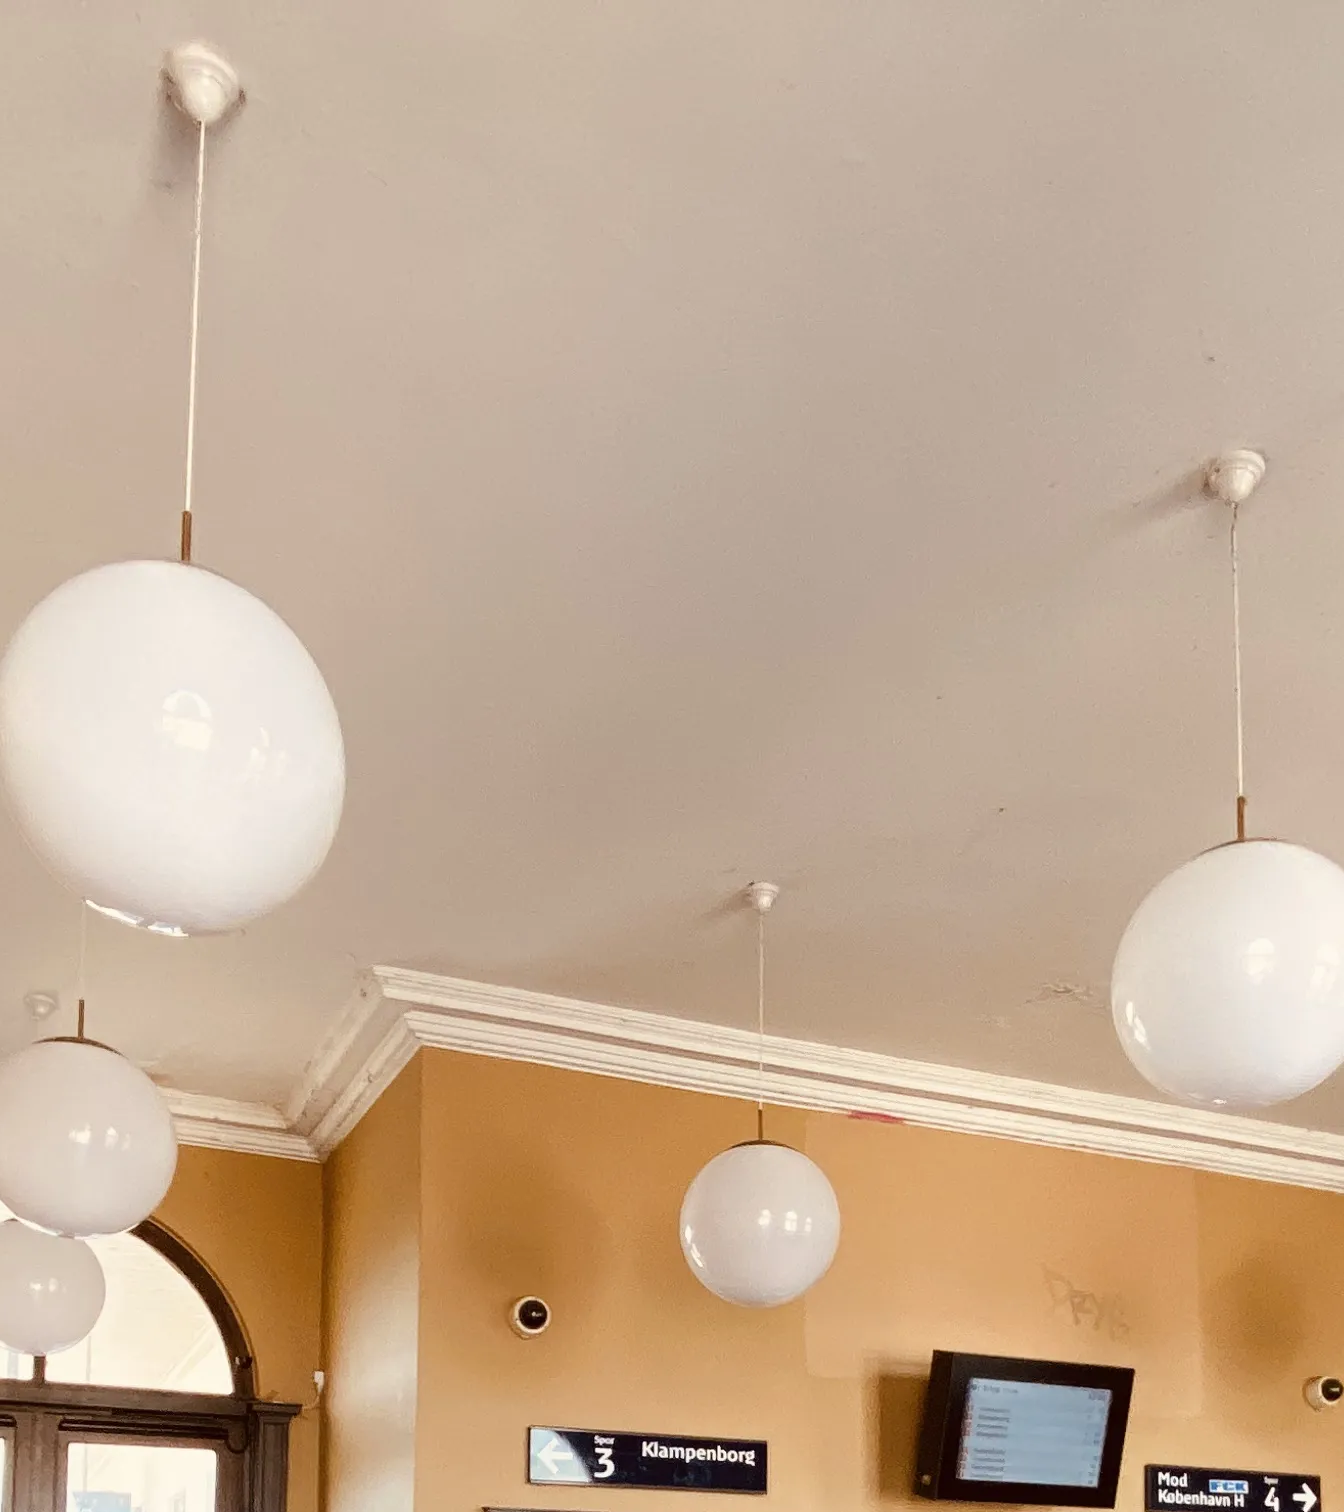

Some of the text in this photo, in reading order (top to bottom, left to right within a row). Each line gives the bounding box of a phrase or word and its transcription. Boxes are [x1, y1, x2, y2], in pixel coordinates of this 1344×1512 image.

[594, 1435, 615, 1446] Spor
[593, 1447, 615, 1478] 3
[641, 1441, 756, 1466] Klampenborg
[1158, 1472, 1188, 1487] Mod
[1158, 1488, 1245, 1507] København H
[1264, 1486, 1280, 1512] 4
